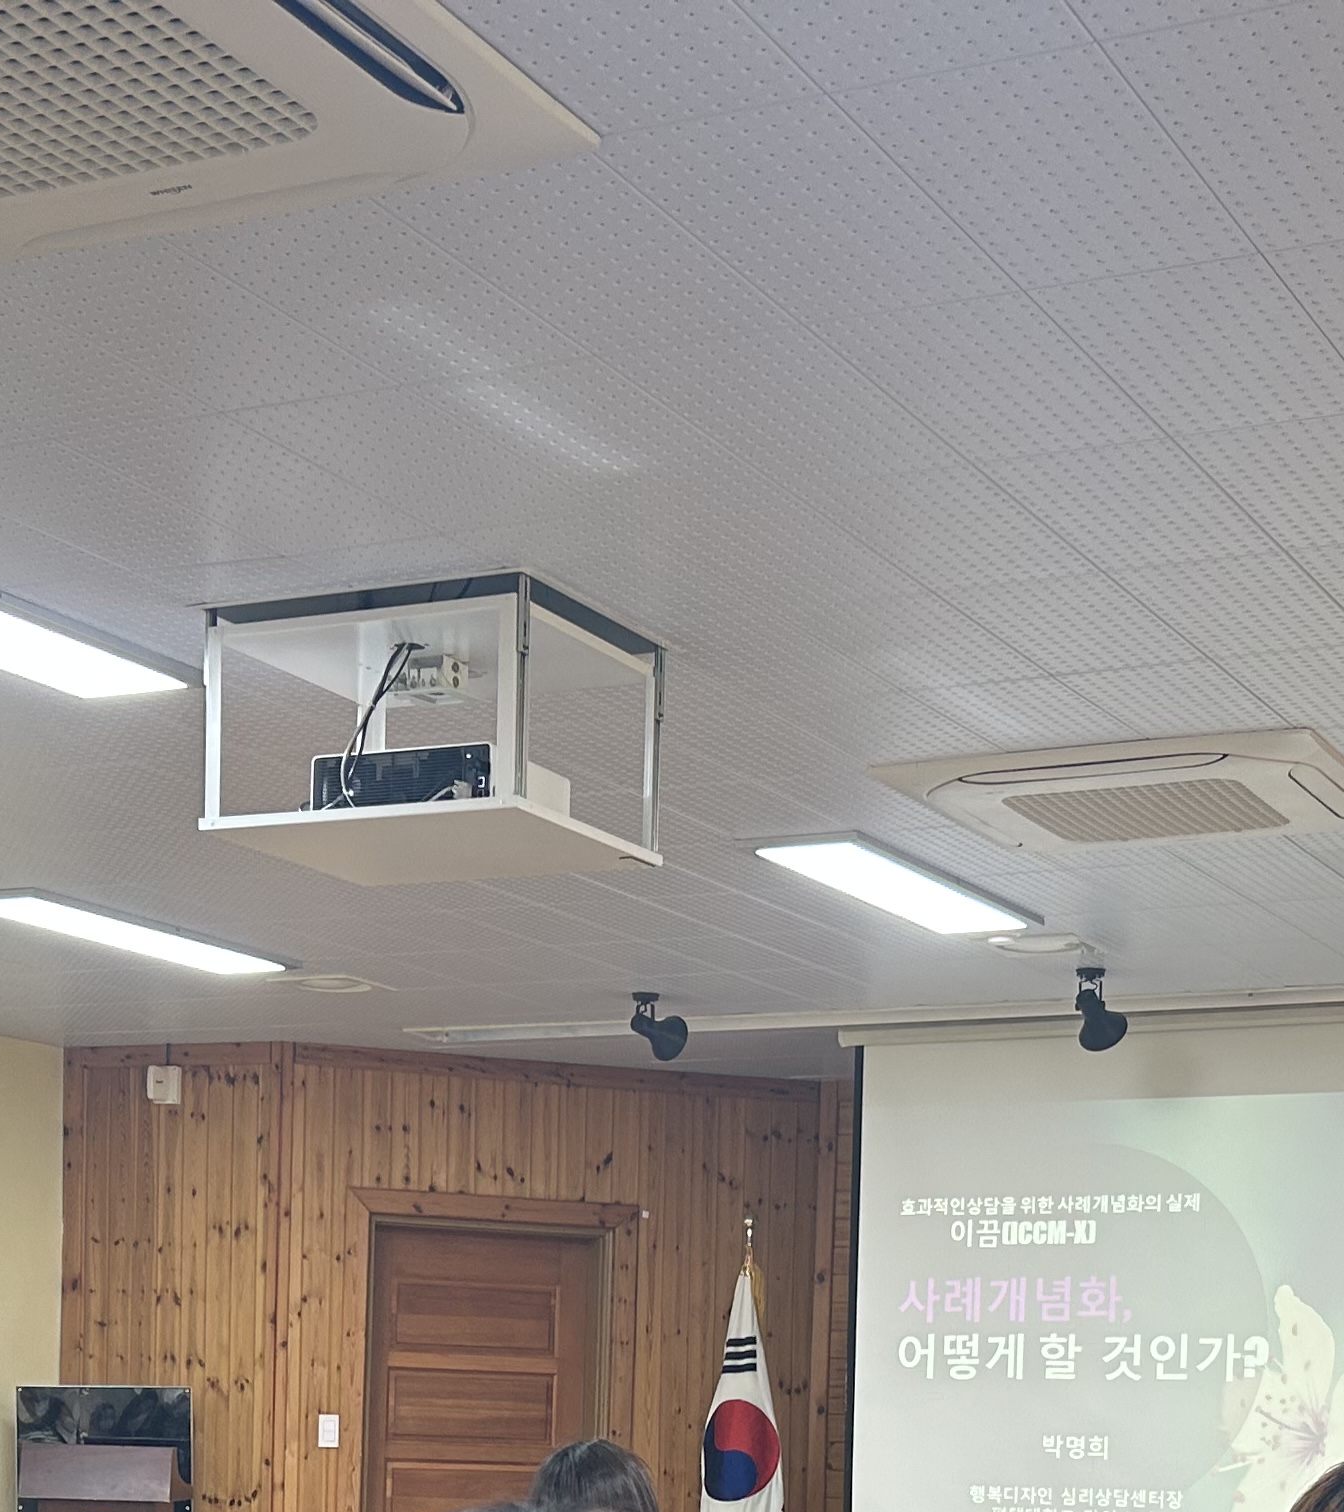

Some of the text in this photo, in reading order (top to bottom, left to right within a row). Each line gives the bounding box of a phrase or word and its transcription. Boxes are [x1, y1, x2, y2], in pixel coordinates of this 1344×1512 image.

[899, 1192, 1201, 1217] 효과적인상담을 위한 사례개념화의 실제
[897, 1274, 1133, 1325] 사례개념화,
[897, 1332, 1270, 1382] 어떻게 할 것인가?
[1041, 1434, 1109, 1461] 박명희
[968, 1484, 1184, 1510] 행복디자인 심리상담센터장
